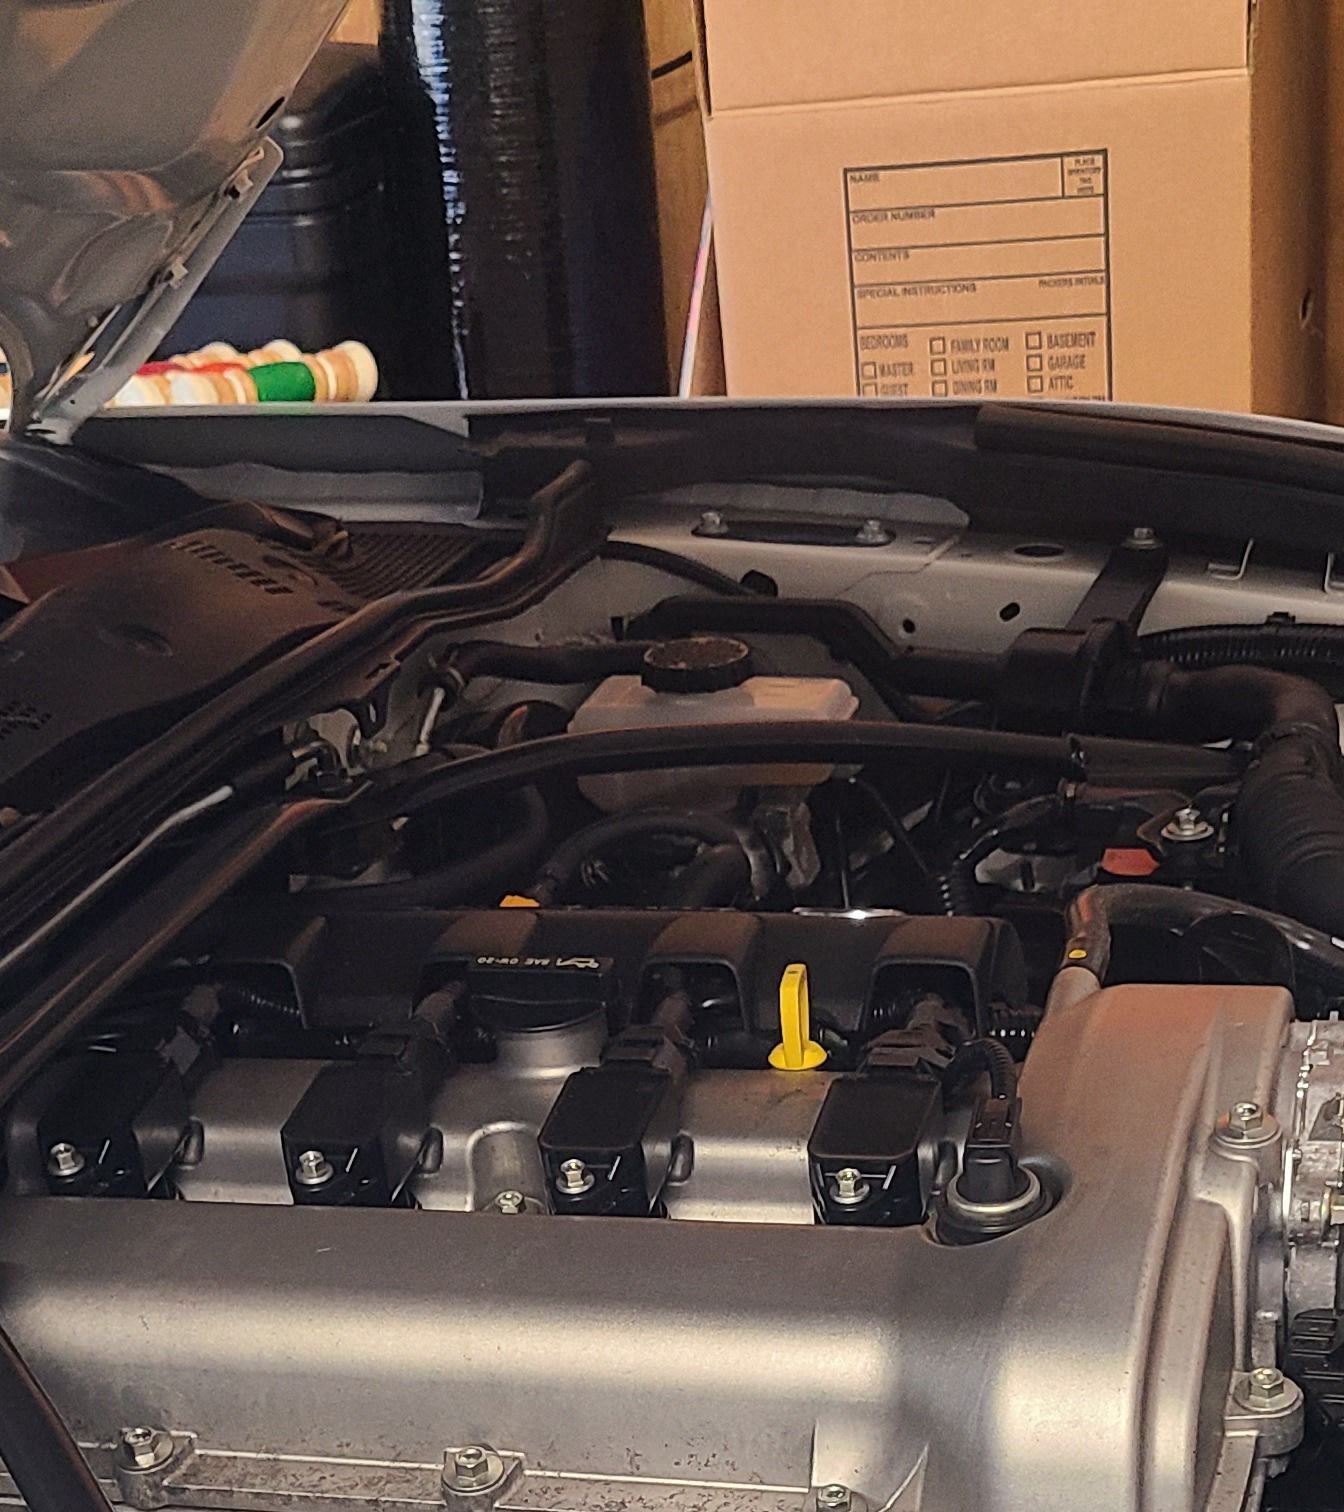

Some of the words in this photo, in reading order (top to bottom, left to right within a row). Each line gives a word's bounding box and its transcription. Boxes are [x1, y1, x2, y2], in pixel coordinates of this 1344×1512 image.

[850, 172, 880, 183] NAME
[852, 210, 889, 224] ORDER
[890, 207, 935, 221] NUMBER
[854, 248, 910, 262] CONTENTS
[856, 286, 900, 299] SPECIAL
[901, 282, 977, 297] INSTRUCTIONS
[860, 334, 909, 351] BEDROOMS
[951, 338, 981, 353] FAMILY
[982, 335, 1010, 352] ROOM
[1047, 331, 1096, 349] BASEMENT
[880, 361, 913, 378] MASTER
[951, 358, 980, 375] LIVING
[982, 357, 996, 373] RM
[1048, 354, 1087, 370] GARAGE
[952, 380, 982, 396] DINING
[983, 378, 998, 393] RM
[1049, 375, 1074, 391] ATTIC
